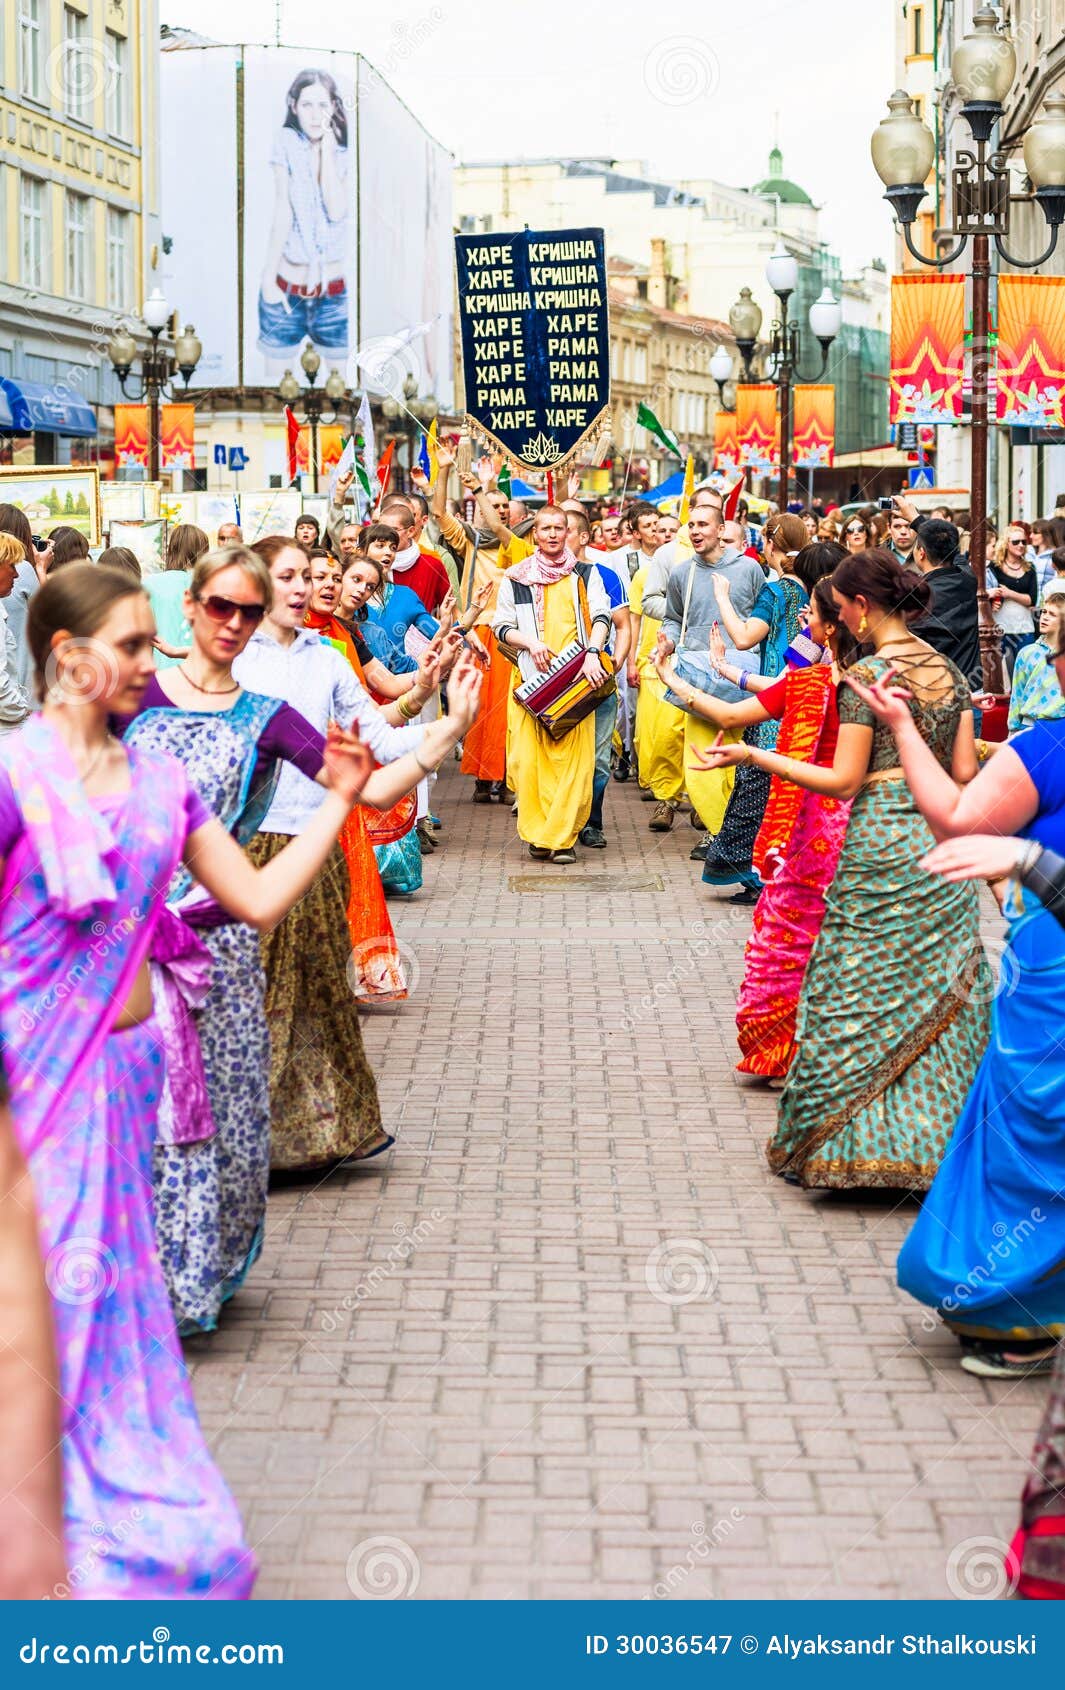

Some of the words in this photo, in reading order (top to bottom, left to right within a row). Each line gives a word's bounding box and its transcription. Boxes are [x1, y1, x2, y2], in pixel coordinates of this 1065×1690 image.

[466, 246, 513, 266] ХАРЕ
[528, 240, 597, 262] КРИШНА
[468, 269, 514, 289] ХАРЕ
[531, 265, 598, 285] КРИШНА
[465, 291, 531, 313] КРИШНА
[535, 288, 601, 309] КРИШНА
[473, 317, 522, 337] ХАРЕ
[547, 313, 598, 333] ХАРЕ
[475, 339, 524, 360] ХАРЕ
[548, 337, 599, 356] РАМА
[476, 363, 526, 384] ХАРЕ
[549, 361, 599, 379] РАМА
[477, 388, 527, 407] РАМА
[550, 384, 599, 403] РАМА
[491, 409, 536, 430] ХАРЕ
[546, 408, 587, 428] ХАРЕ
